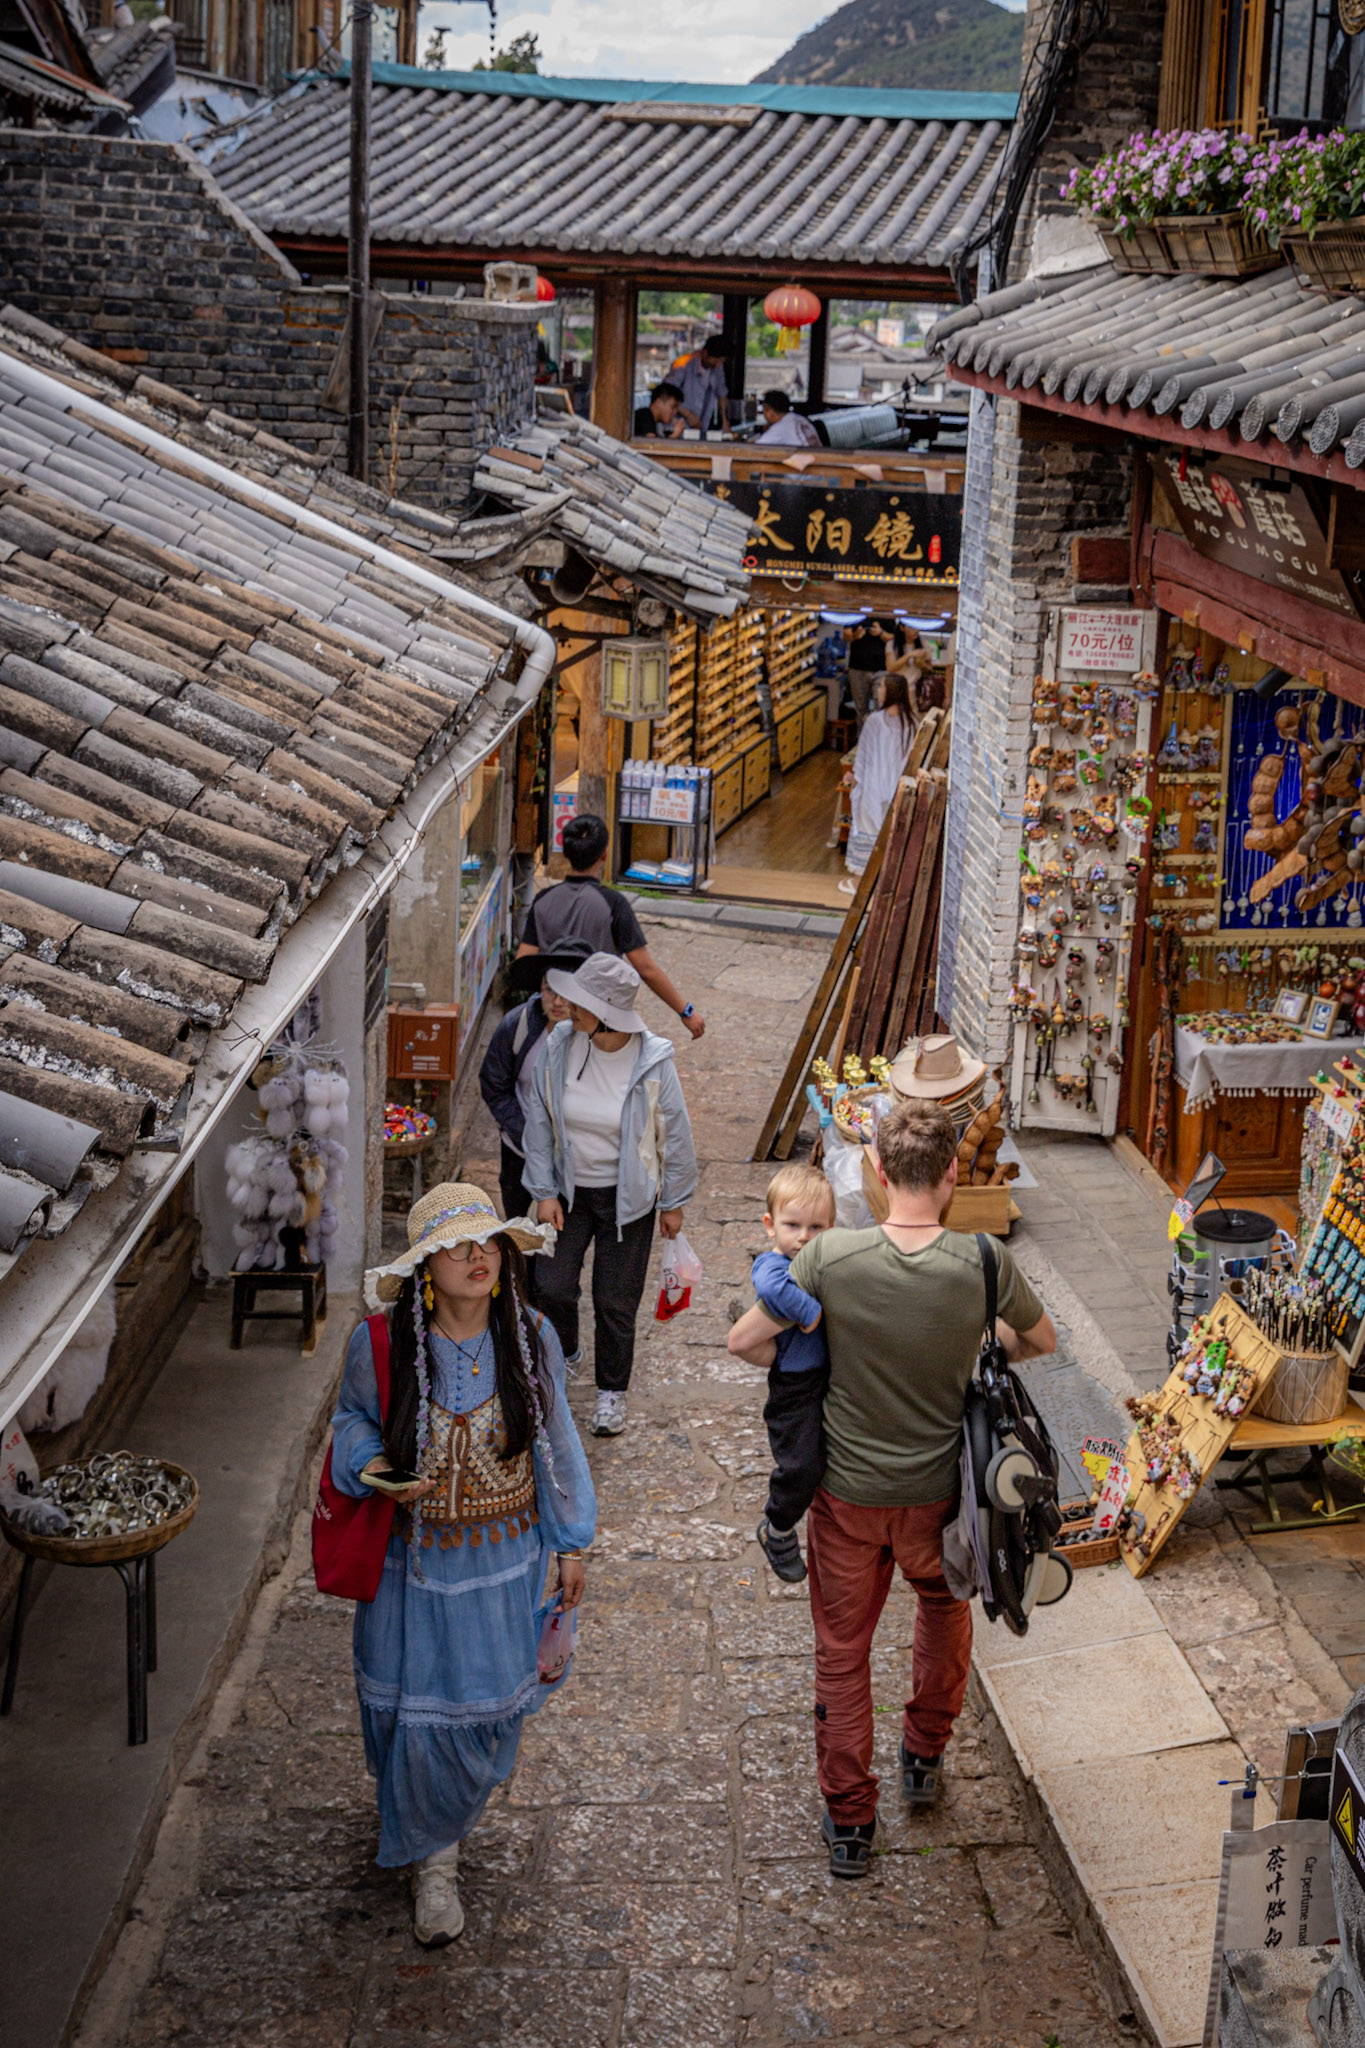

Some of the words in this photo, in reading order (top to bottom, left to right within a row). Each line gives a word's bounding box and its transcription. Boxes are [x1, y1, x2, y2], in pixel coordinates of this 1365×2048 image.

[746, 498, 924, 561] 太阳镜
[1239, 480, 1307, 547] 蘑菇
[1069, 633, 1135, 651] 70元/位
[1304, 1856, 1318, 1874] Car
[1300, 1876, 1313, 1921] perfume
